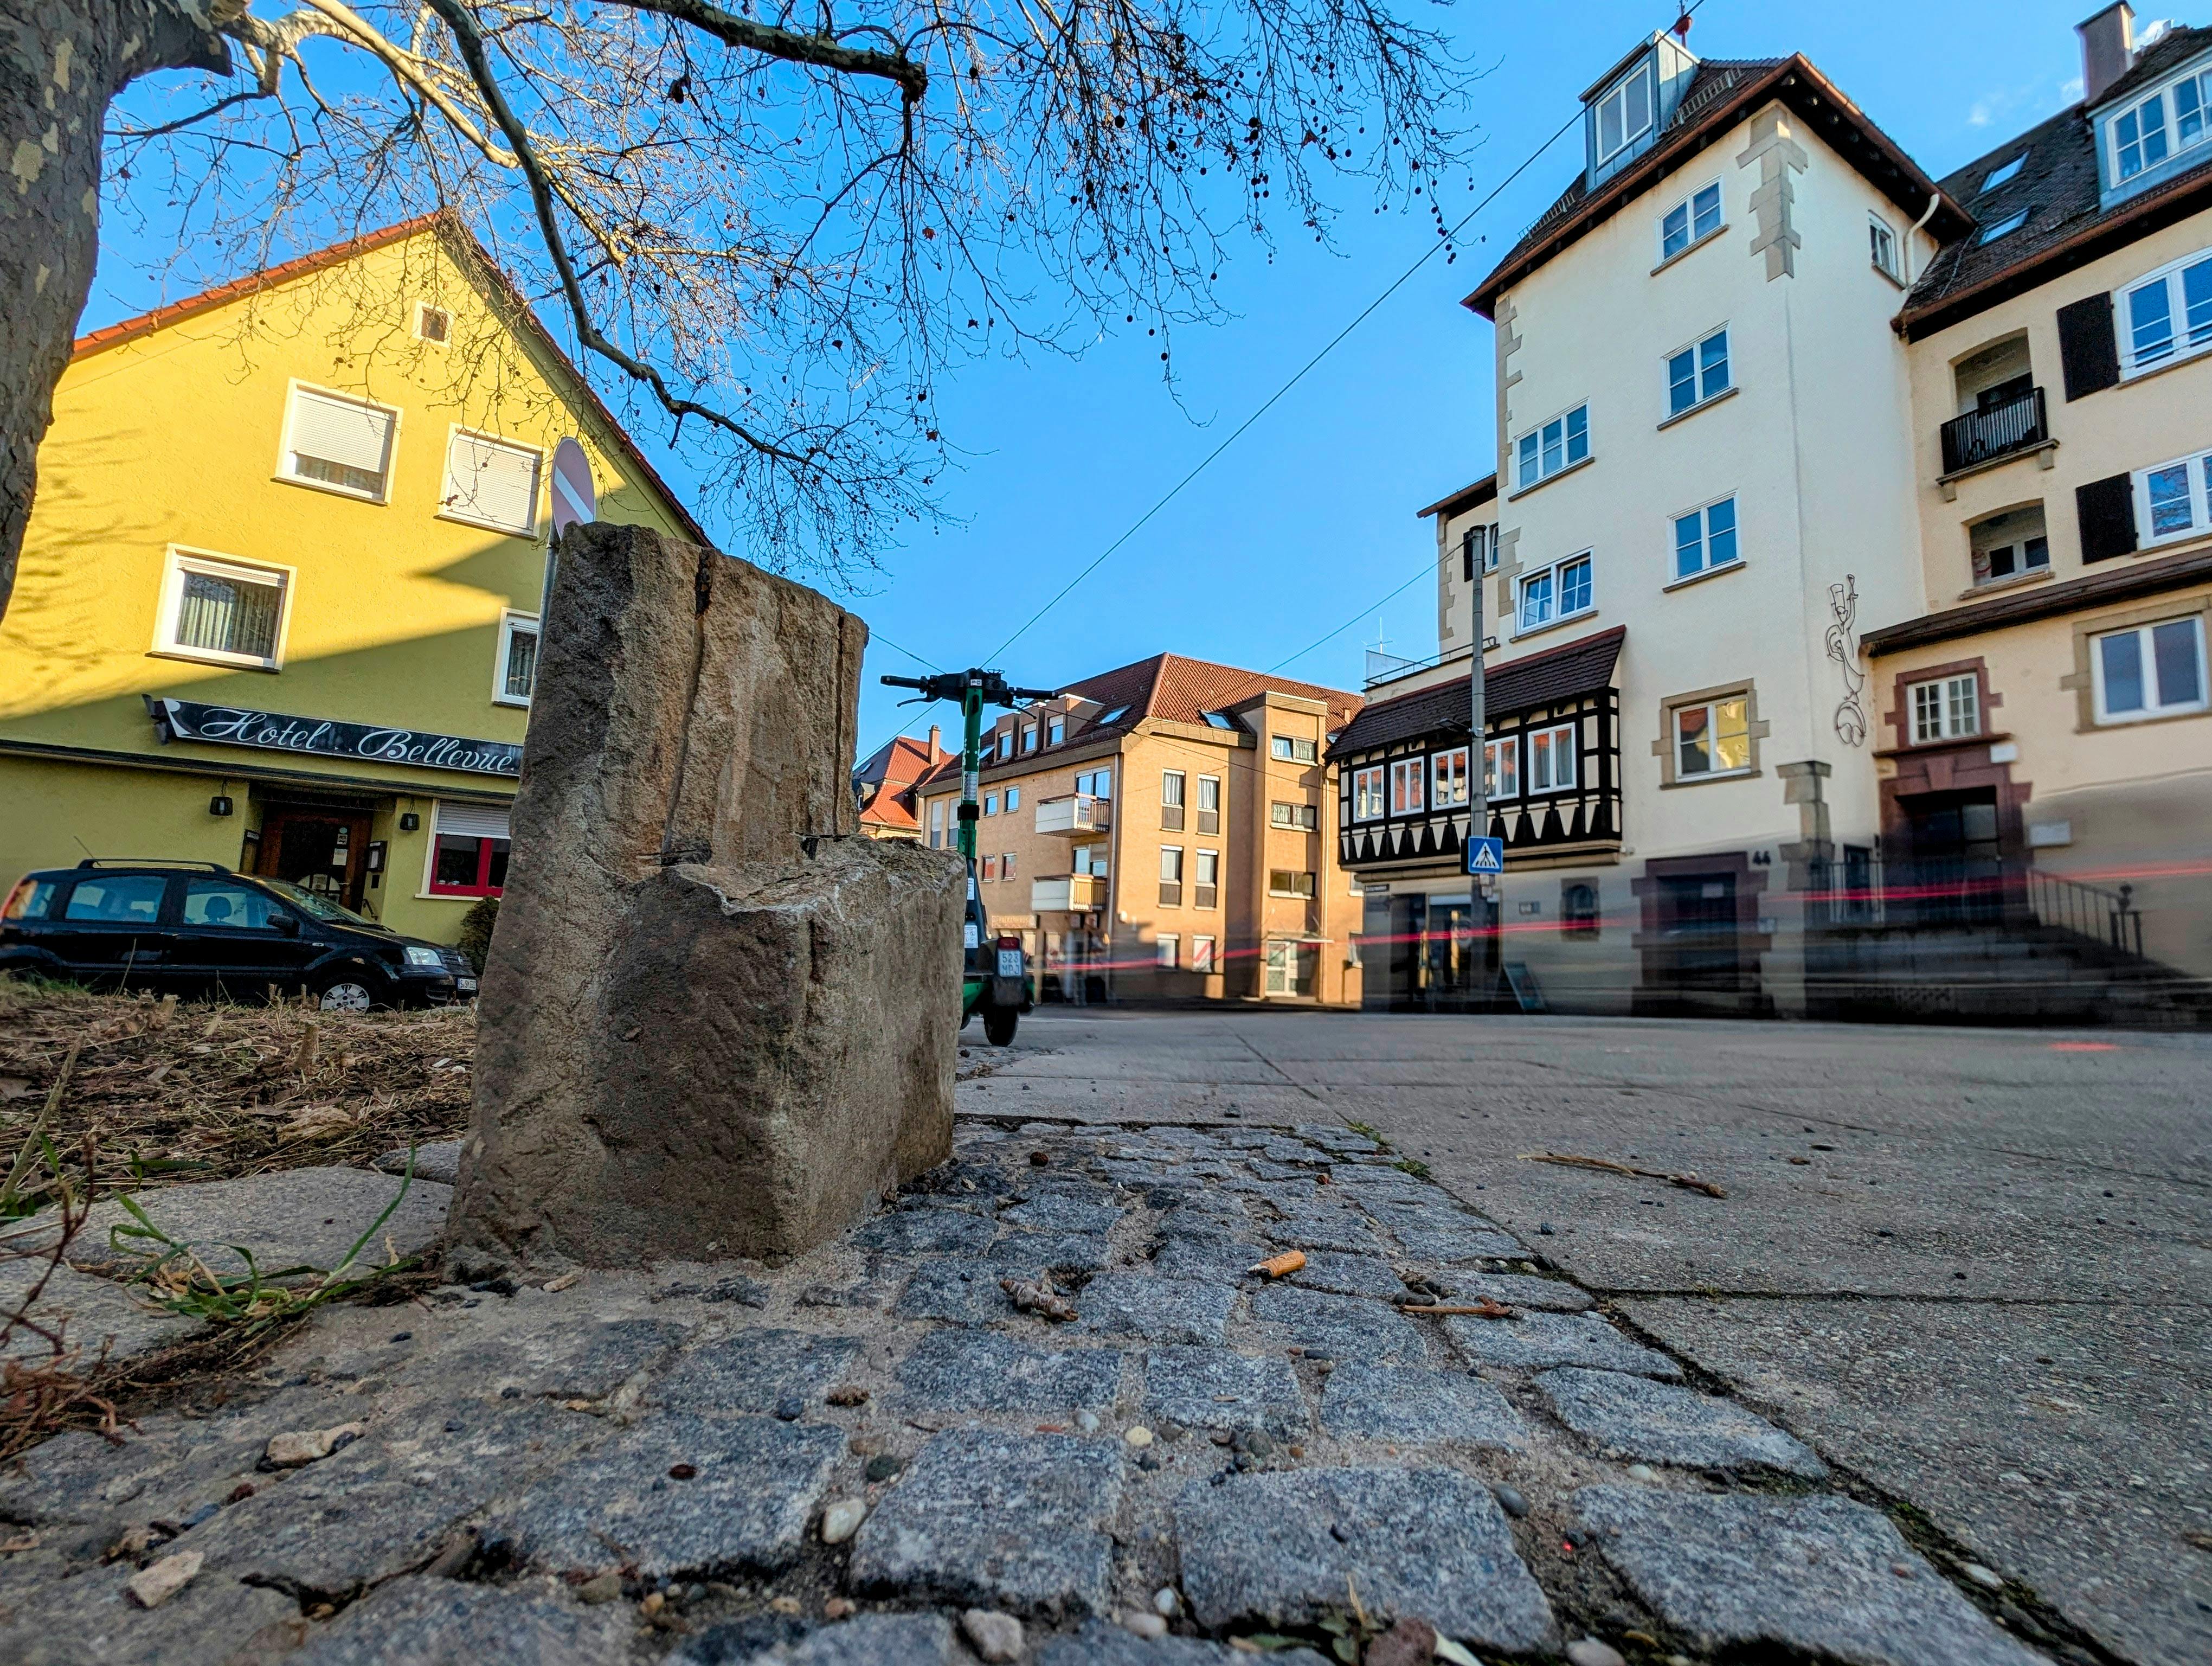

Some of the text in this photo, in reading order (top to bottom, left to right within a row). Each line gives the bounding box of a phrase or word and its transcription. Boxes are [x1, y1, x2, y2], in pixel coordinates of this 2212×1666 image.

[200, 708, 513, 772] Hotel Bellevue
[1002, 953, 1019, 963] 523
[1002, 964, 1019, 975] MPJ
